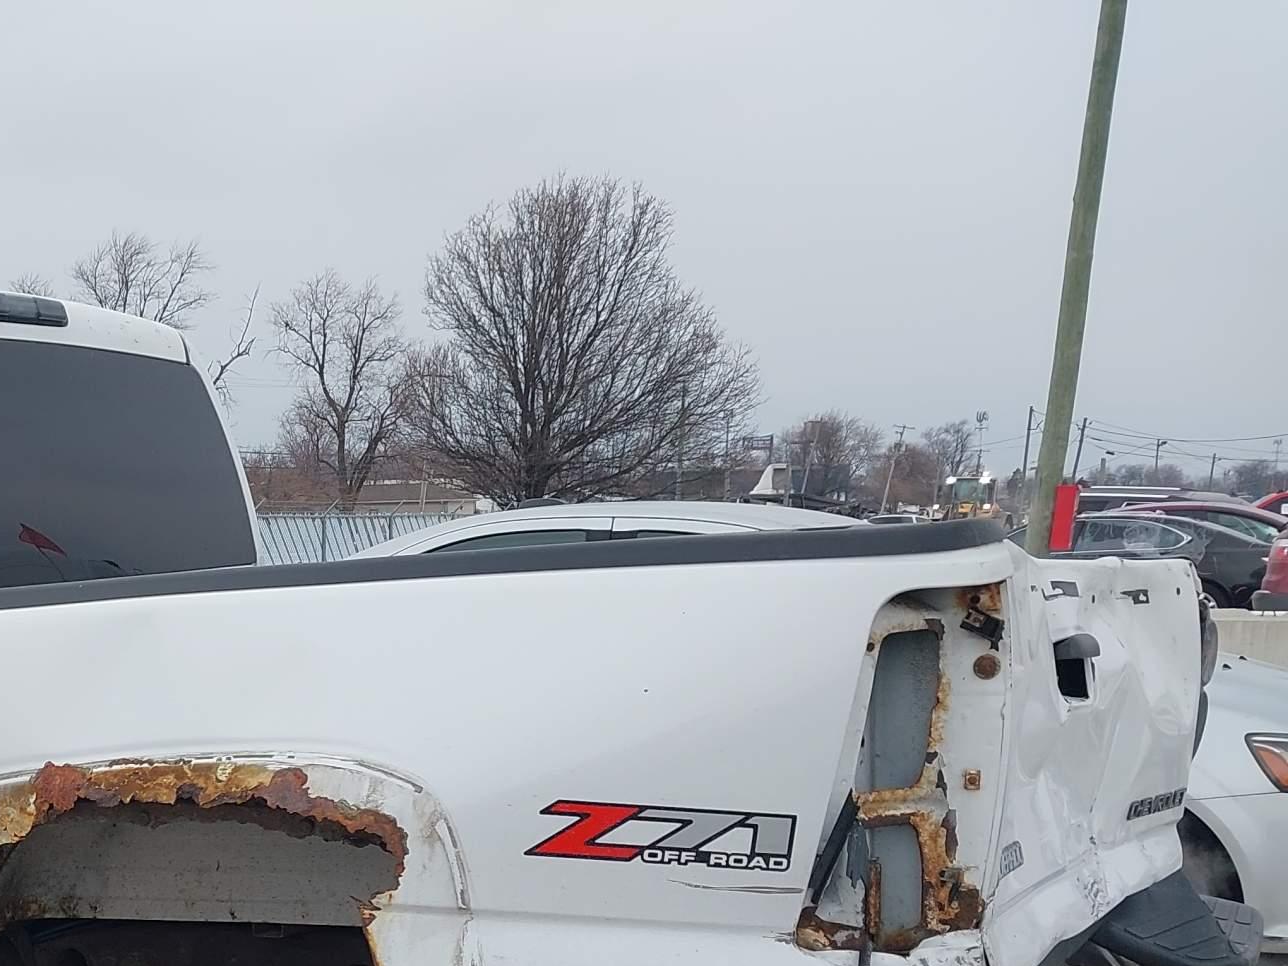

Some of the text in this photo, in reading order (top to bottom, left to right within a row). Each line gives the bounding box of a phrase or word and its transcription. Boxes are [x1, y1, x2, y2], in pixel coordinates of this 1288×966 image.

[524, 799, 797, 862] Z71
[641, 849, 790, 871] OFF ROAD
